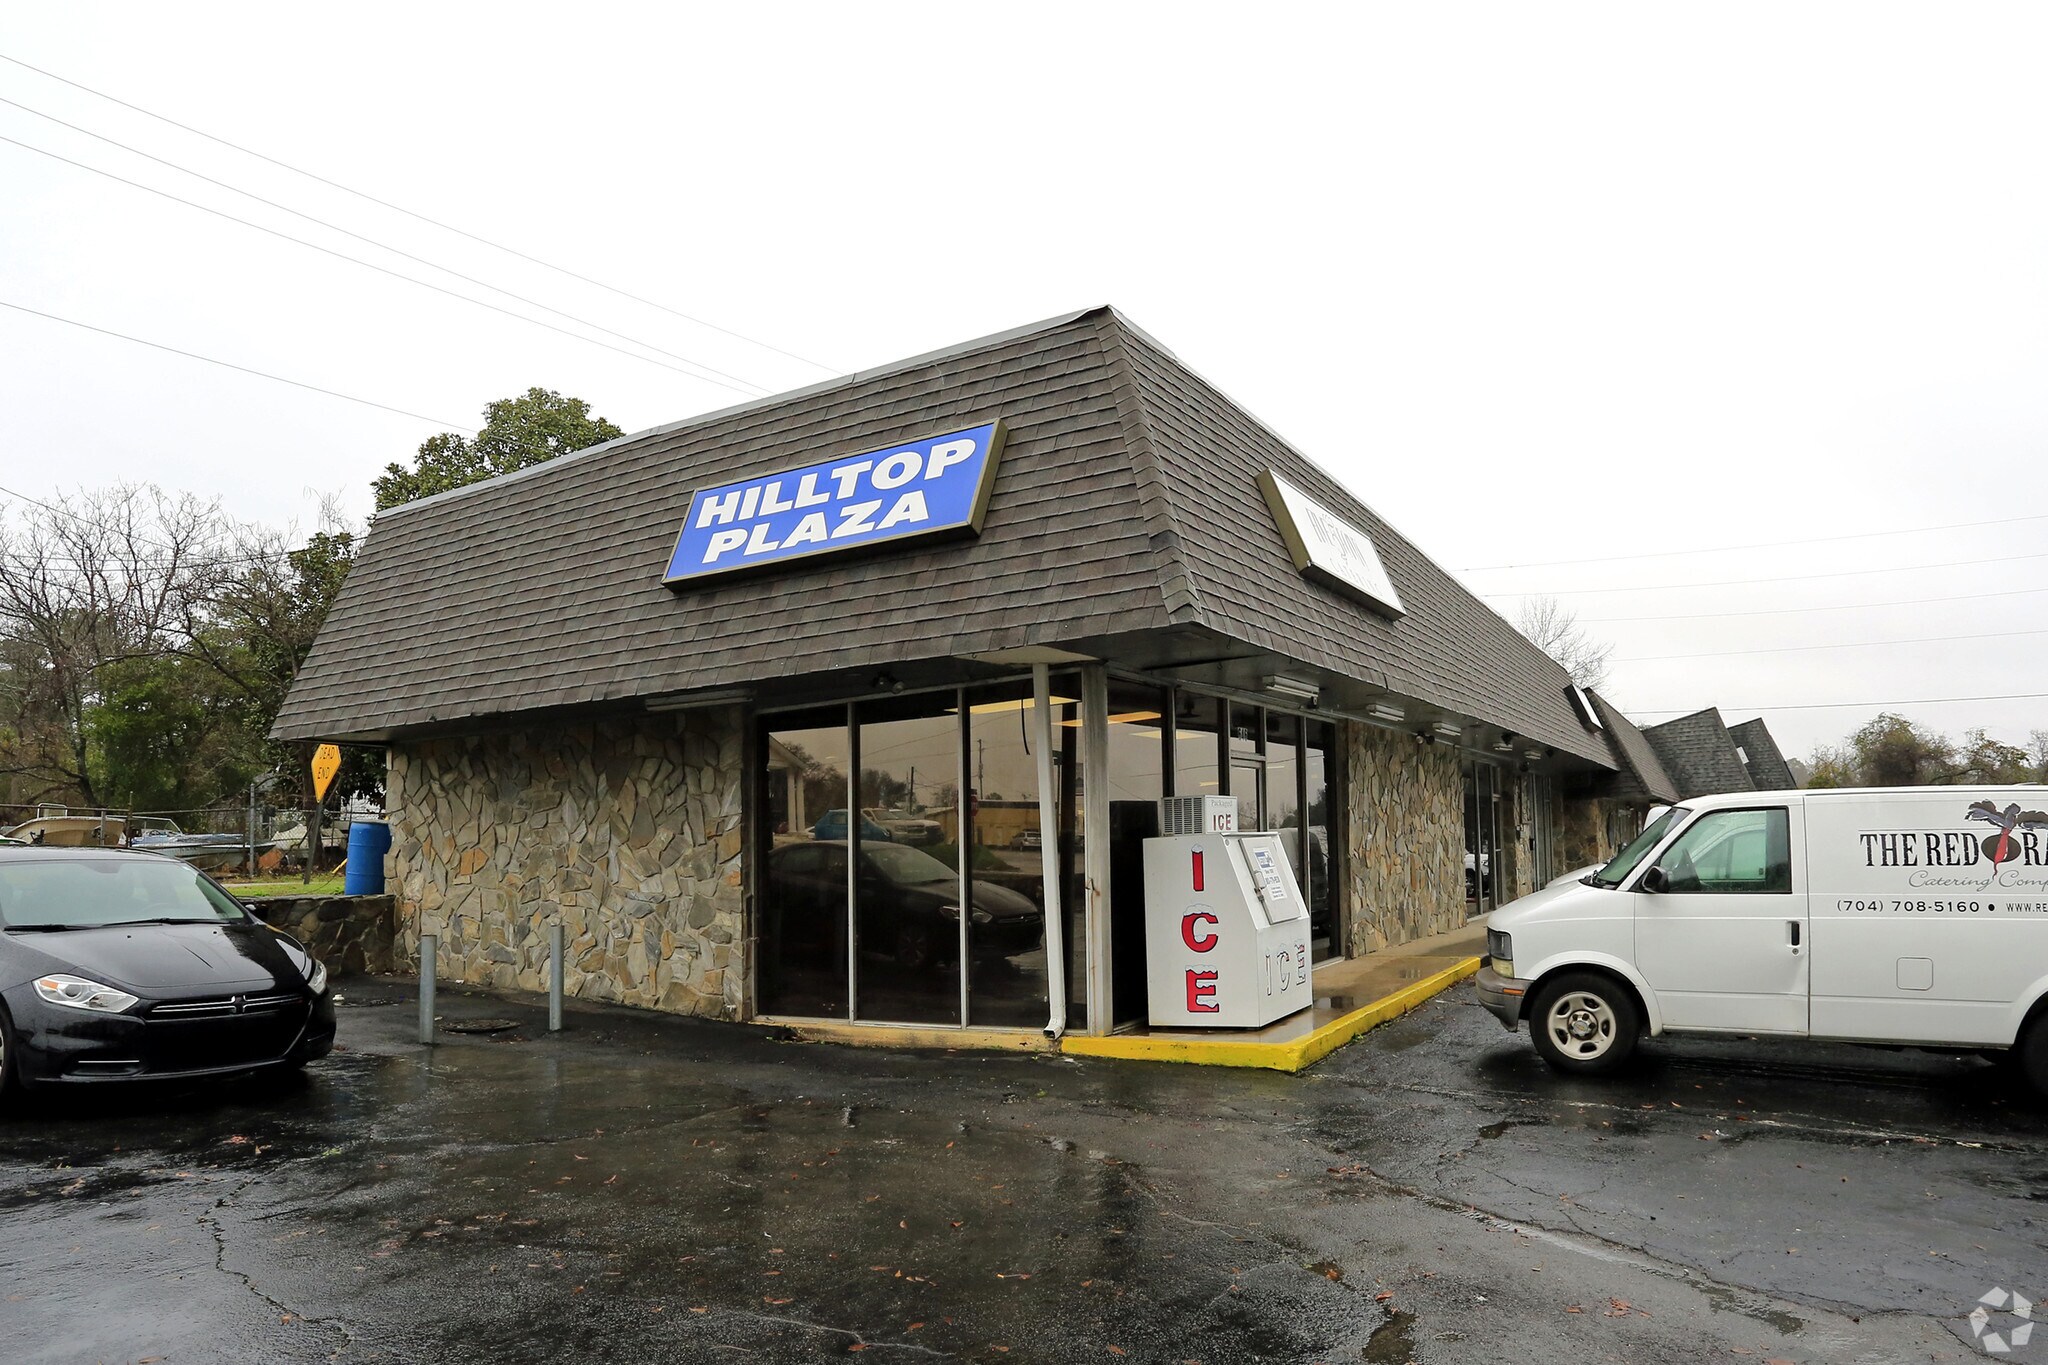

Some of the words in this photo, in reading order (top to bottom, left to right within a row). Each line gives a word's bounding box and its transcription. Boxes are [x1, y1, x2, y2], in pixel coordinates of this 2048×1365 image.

[695, 438, 976, 529] HILLTOP
[701, 490, 929, 564] PLAZA
[319, 746, 336, 760] DEAD
[317, 766, 330, 780] END
[1213, 813, 1232, 832] ICE
[1860, 834, 1918, 866] THE
[1925, 833, 1979, 866] RED
[1909, 870, 1992, 892] Catering
[1837, 900, 1884, 912] (704)
[1892, 900, 1980, 912] 708-5160
[1181, 846, 1219, 1013] ICE
[1265, 942, 1306, 997] ICE
